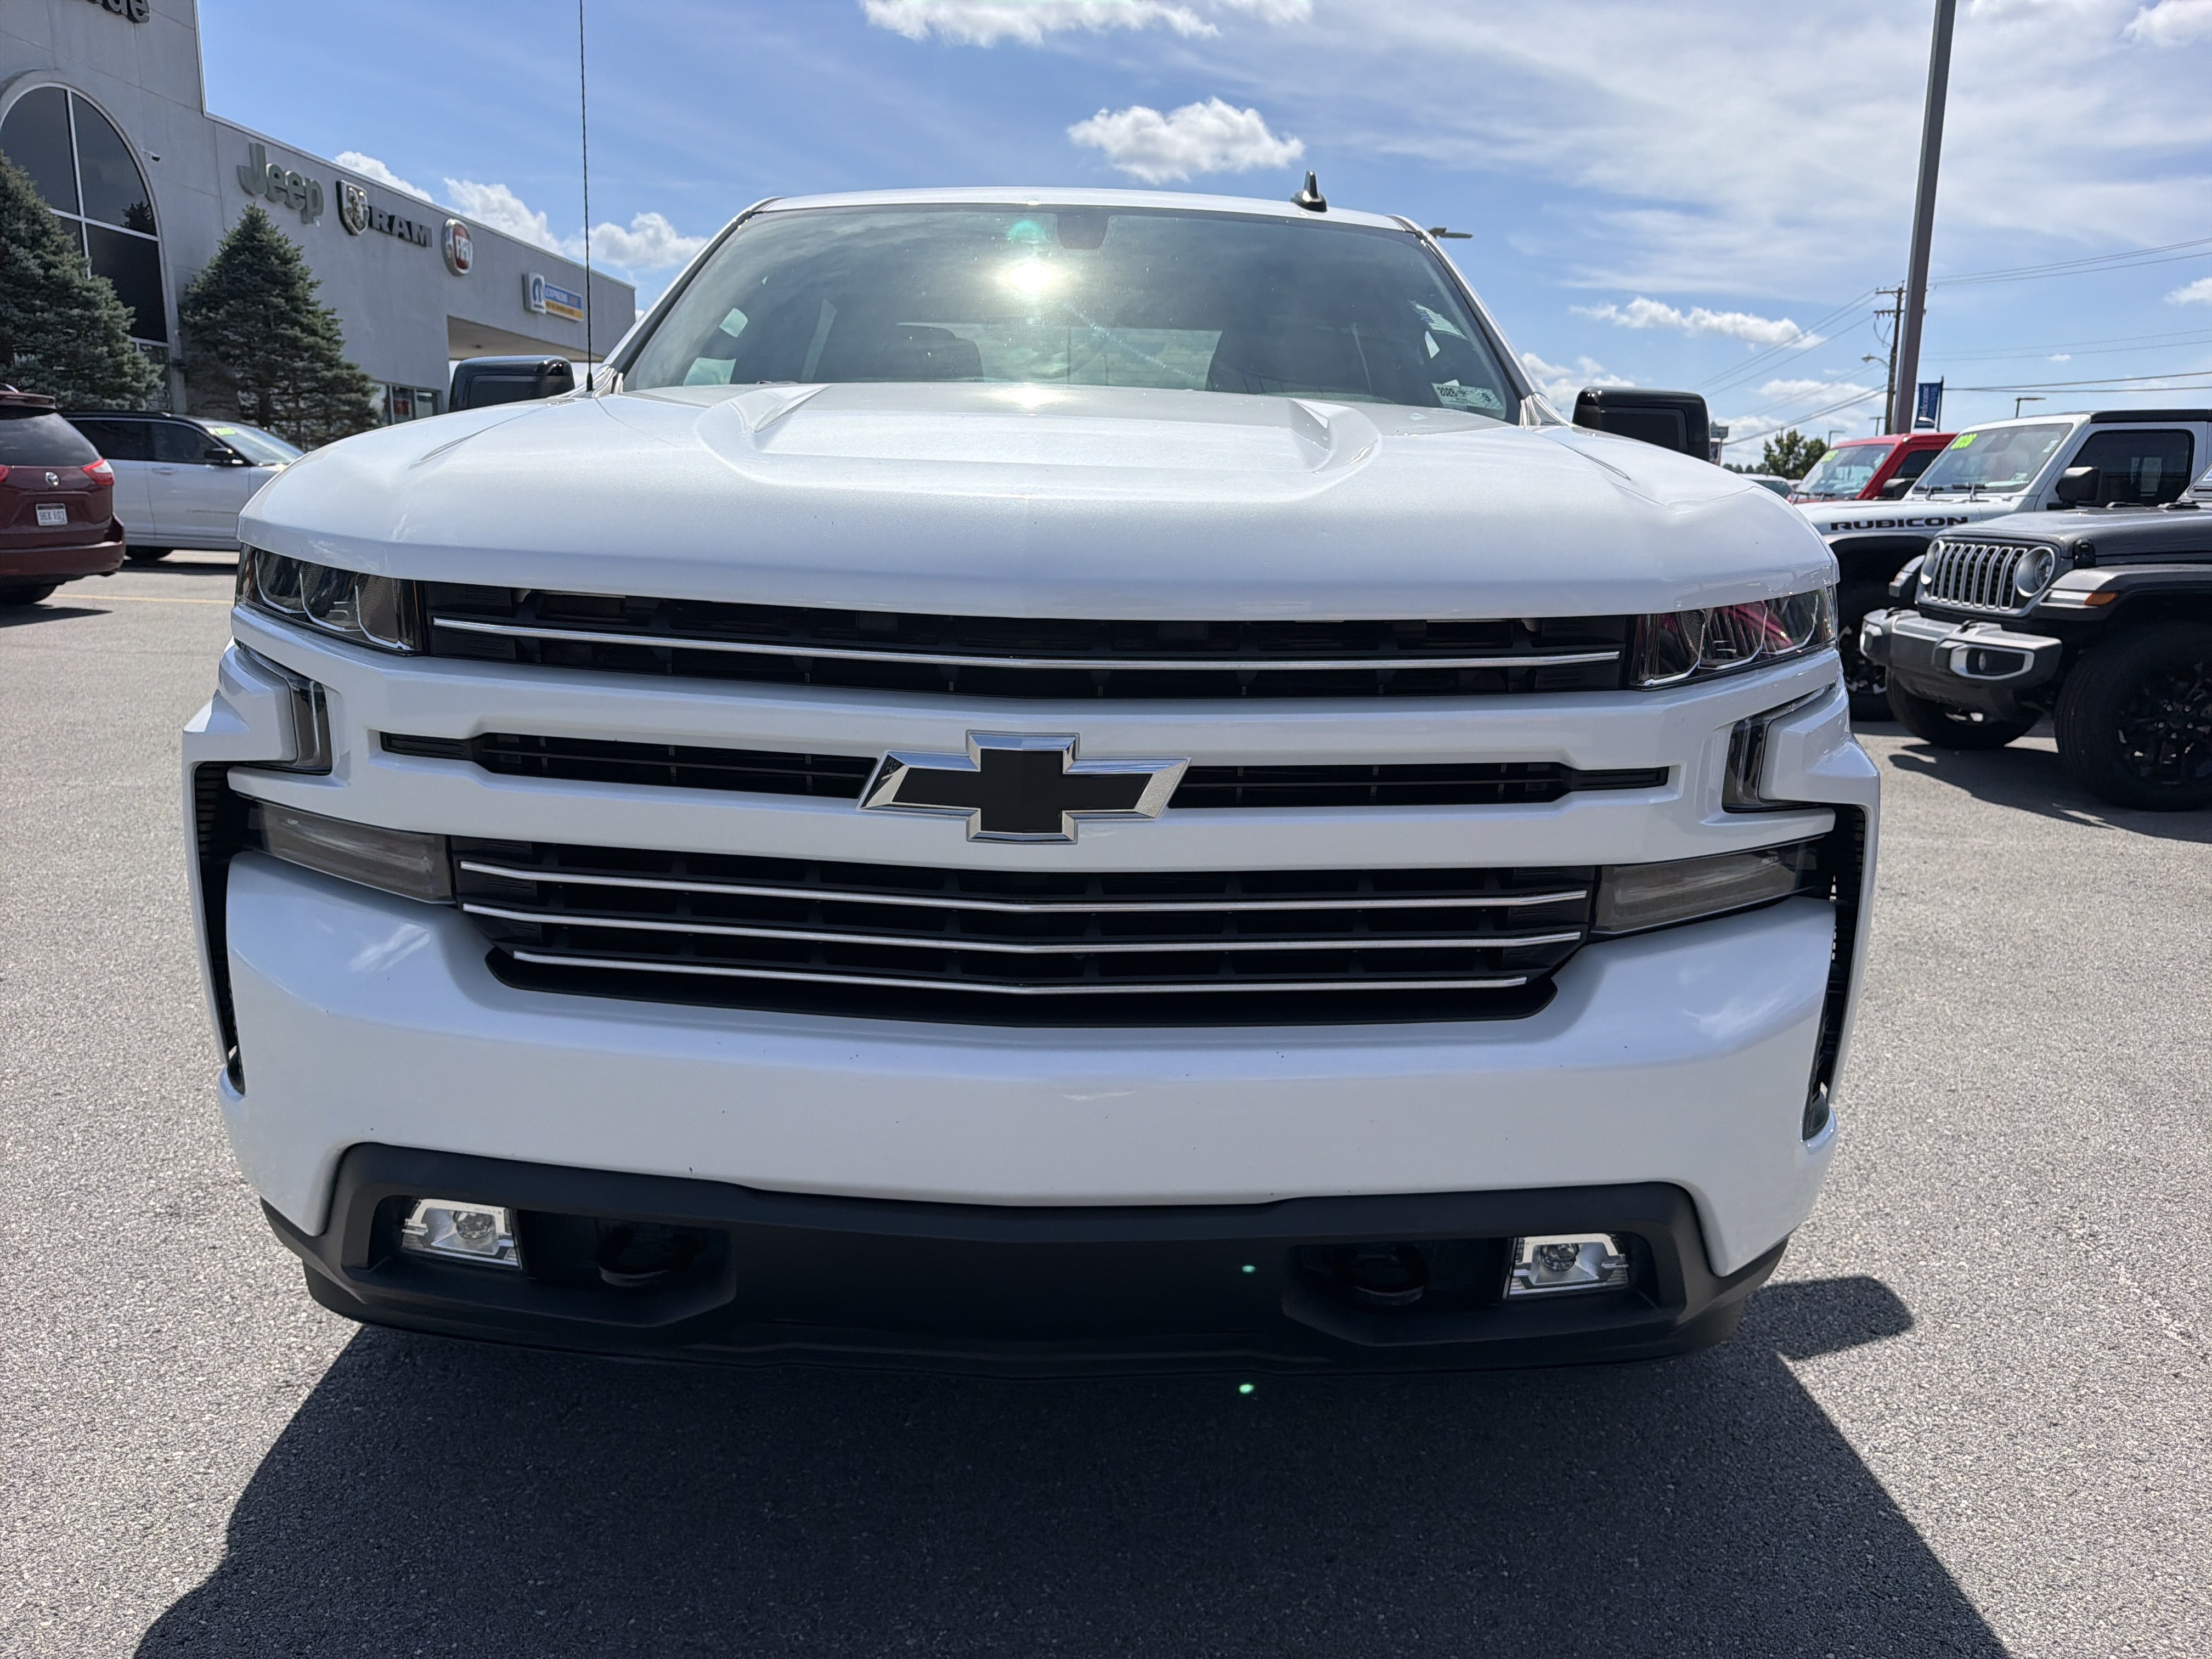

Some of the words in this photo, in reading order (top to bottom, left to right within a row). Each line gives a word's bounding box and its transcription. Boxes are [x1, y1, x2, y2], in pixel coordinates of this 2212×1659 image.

[236, 143, 324, 225] Jeep
[368, 206, 433, 247] RAM
[1830, 516, 1968, 531] RUBICON
